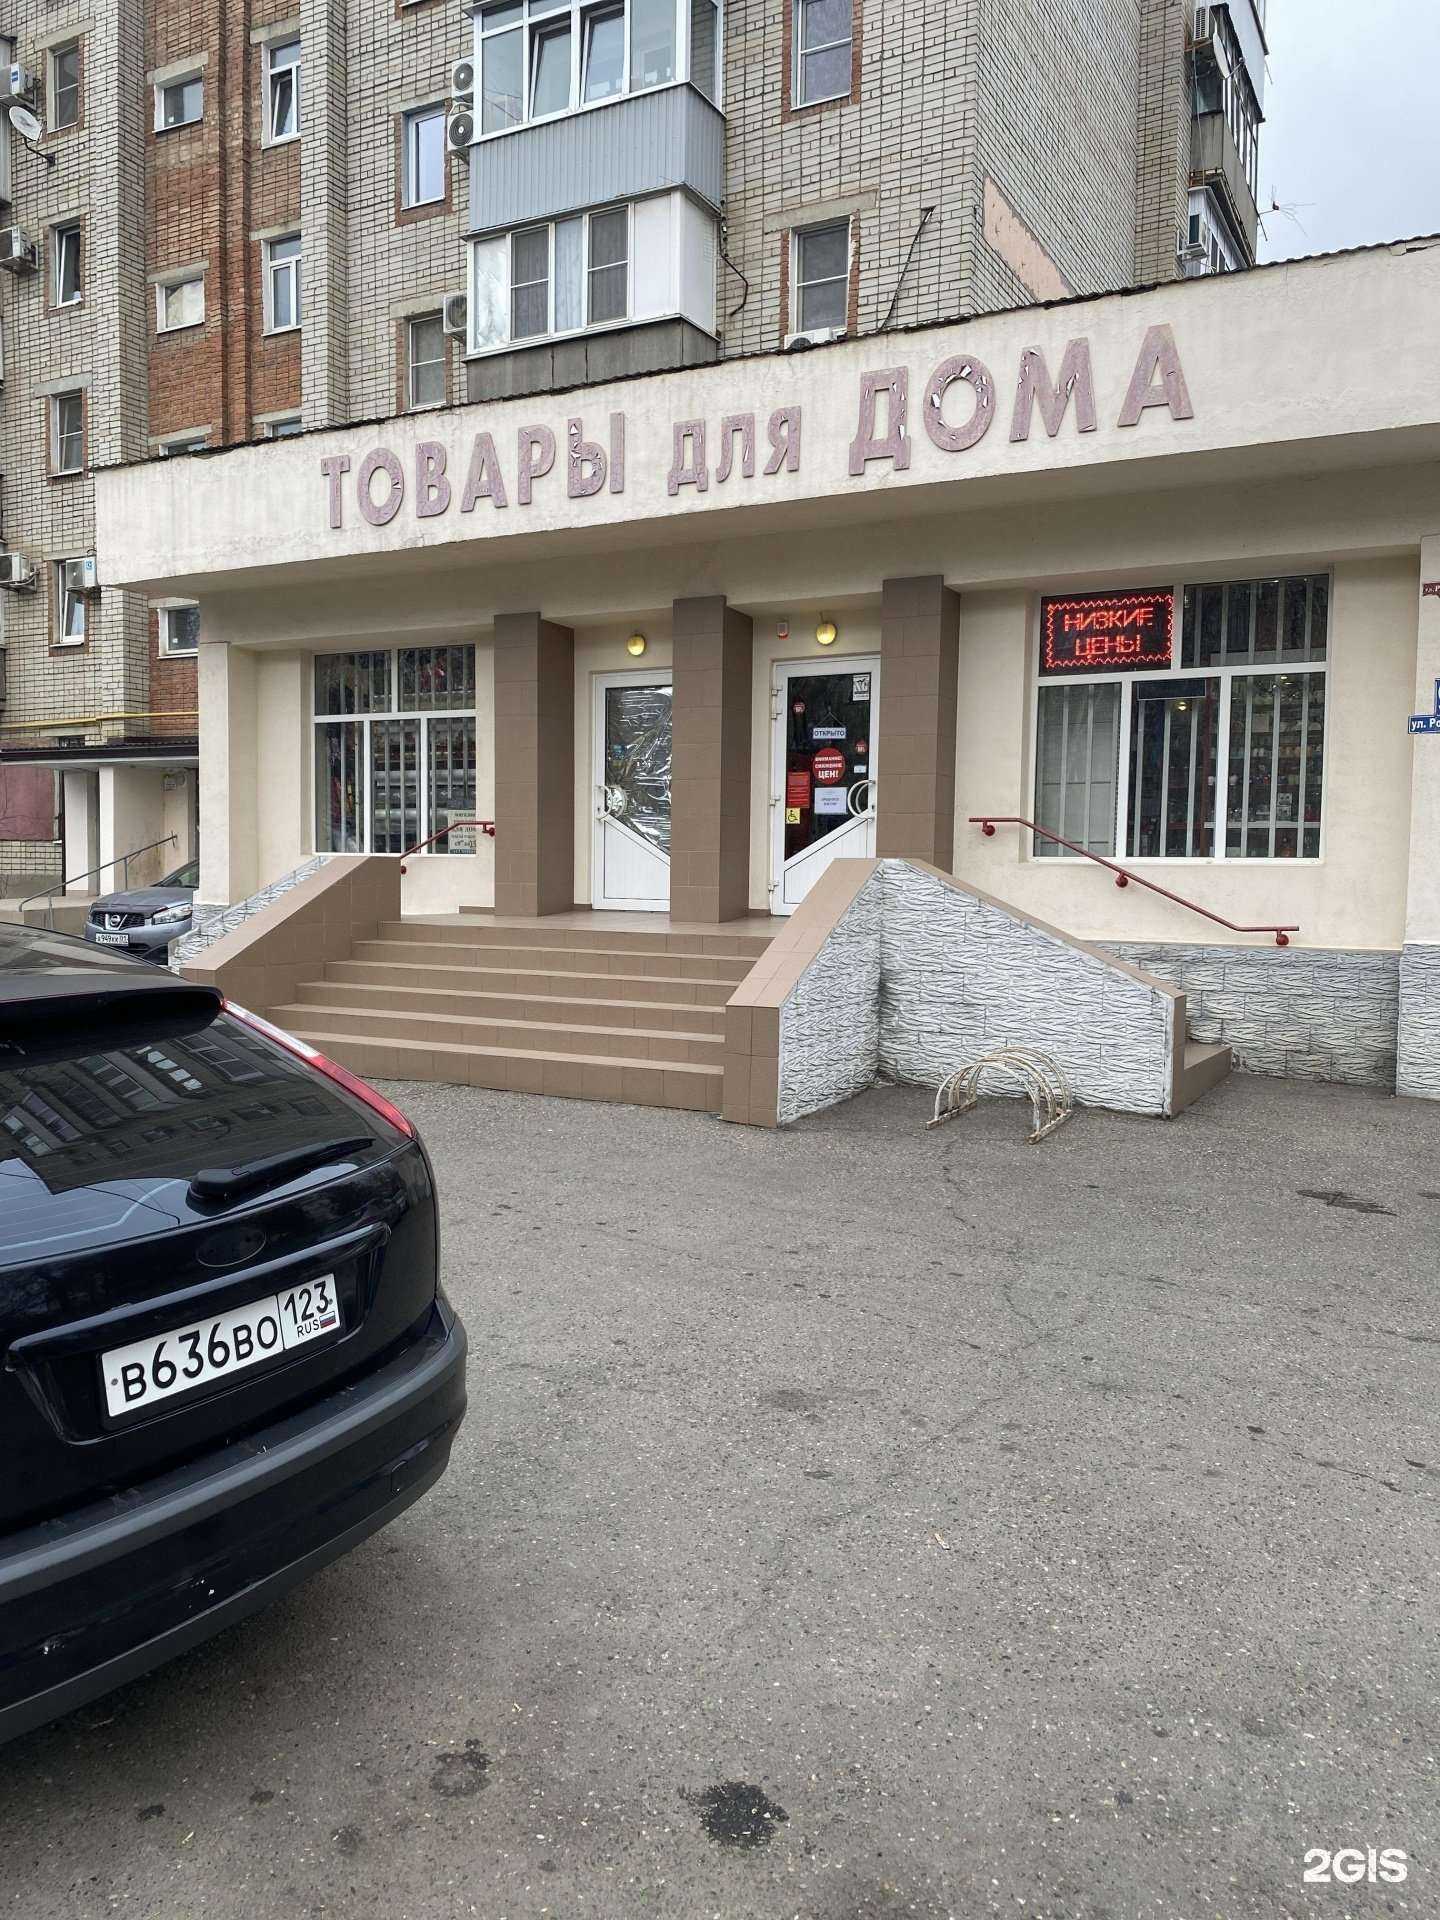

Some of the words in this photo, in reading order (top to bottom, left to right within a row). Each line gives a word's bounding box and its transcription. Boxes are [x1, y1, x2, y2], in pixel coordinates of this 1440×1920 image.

[320, 410, 625, 529] ТОВАРЫ
[667, 405, 802, 496] ДЛЯ
[848, 323, 1195, 476] ДОМА
[1063, 607, 1154, 632] НИЗКИЕ
[1074, 634, 1141, 660] ЦЕНЫ
[1411, 720, 1427, 732] ул.
[818, 770, 839, 779] ЦЕН!
[121, 1315, 278, 1402] В636ВО
[284, 1280, 330, 1325] 123
[296, 1319, 320, 1338] RUS
